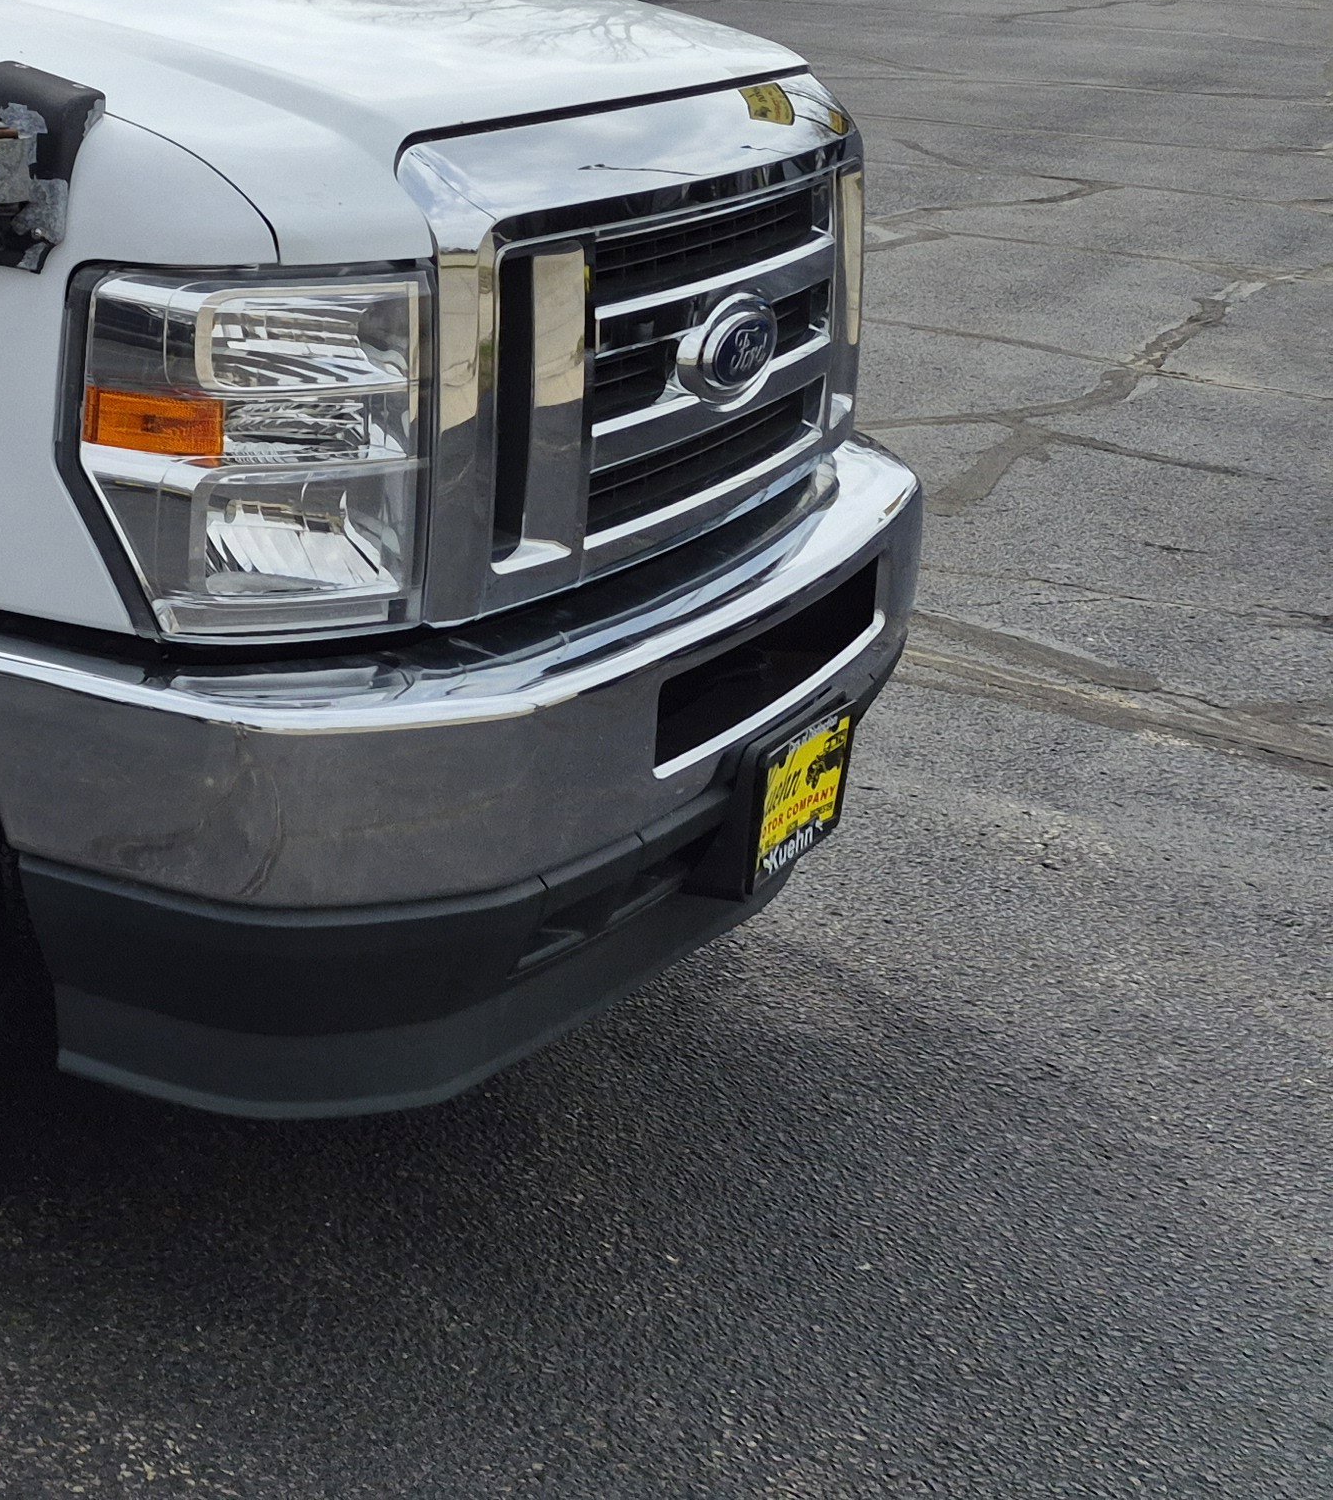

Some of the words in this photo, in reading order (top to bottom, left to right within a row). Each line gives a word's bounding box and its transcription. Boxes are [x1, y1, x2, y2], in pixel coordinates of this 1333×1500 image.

[730, 326, 768, 376] Ford
[762, 813, 784, 839] OTOR
[786, 785, 836, 819] COMPANY
[769, 826, 814, 870] Kuehn
